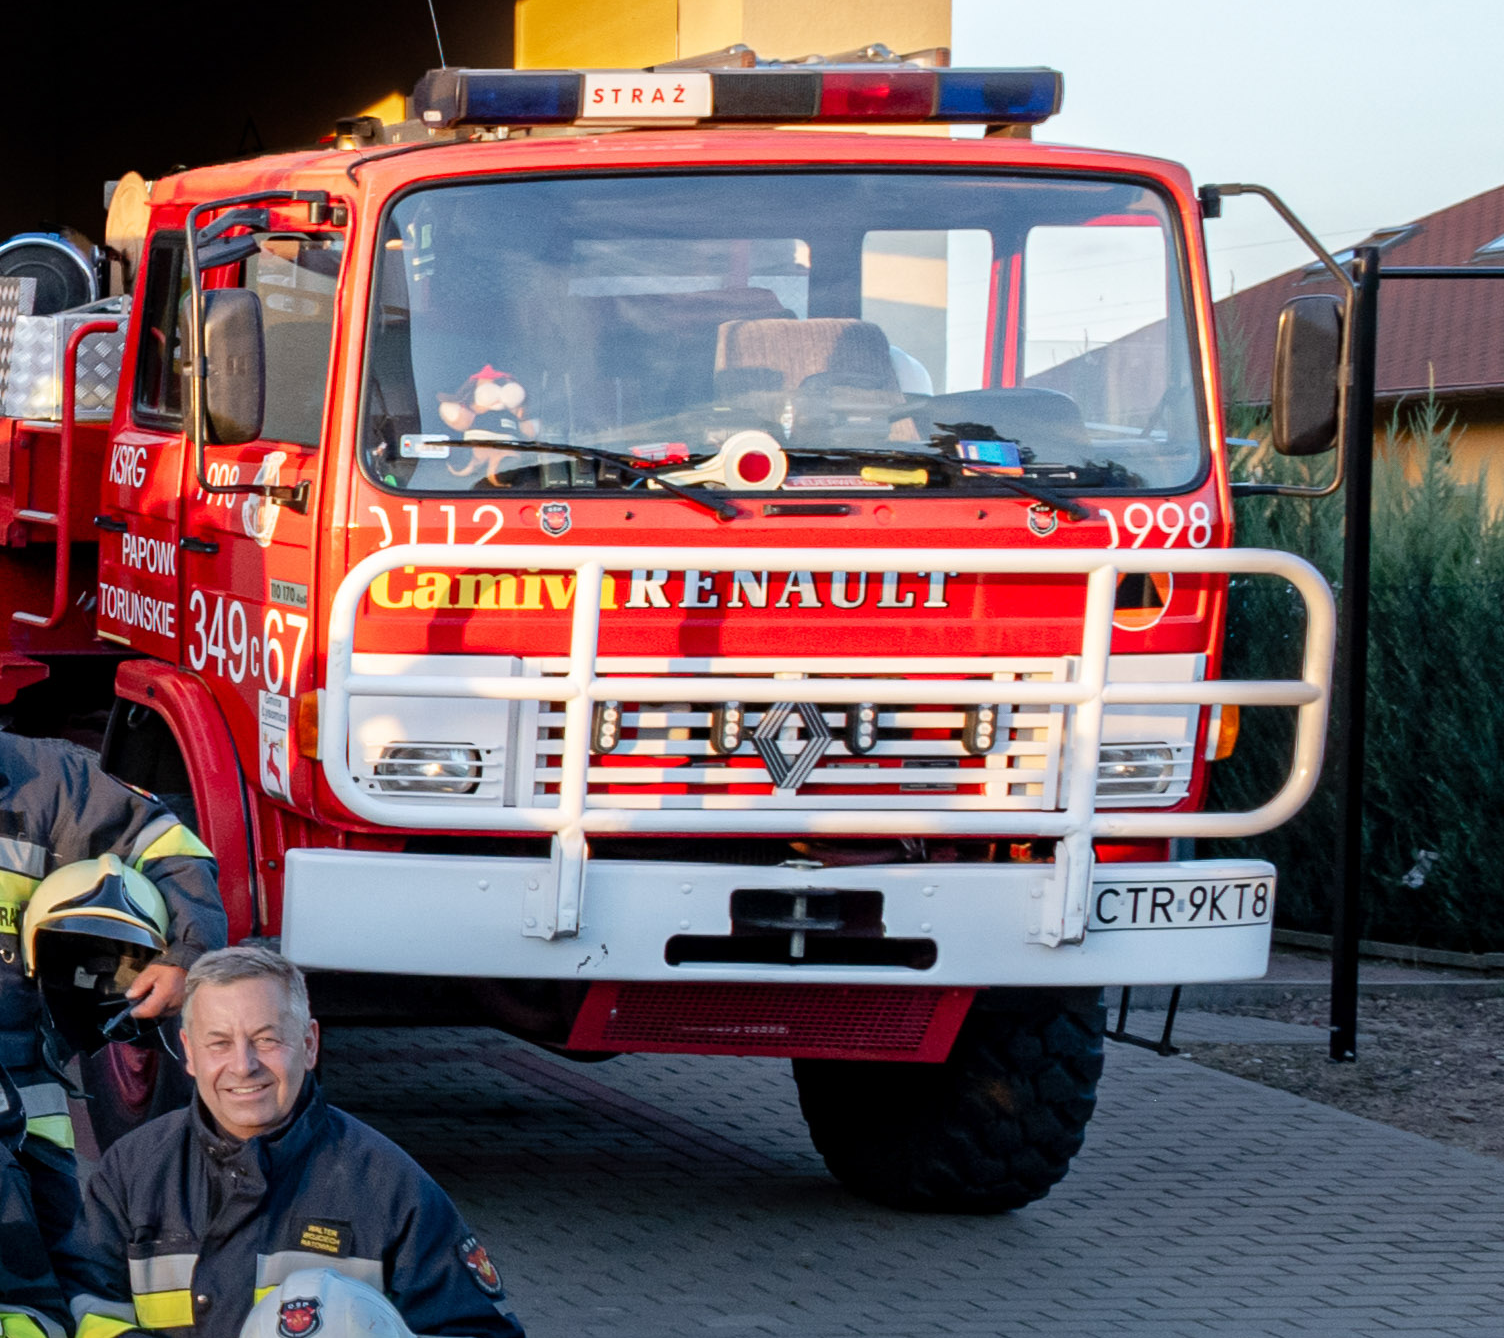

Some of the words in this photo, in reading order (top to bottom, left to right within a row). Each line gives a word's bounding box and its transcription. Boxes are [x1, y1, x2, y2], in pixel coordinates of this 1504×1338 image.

[592, 82, 687, 104] STRAŻ
[109, 444, 147, 487] KSRG
[402, 505, 504, 545] 112
[1123, 501, 1212, 548] 998
[625, 569, 962, 609] RENAULT
[1095, 887, 1173, 924] CTR
[1187, 882, 1268, 923] 9KT8
